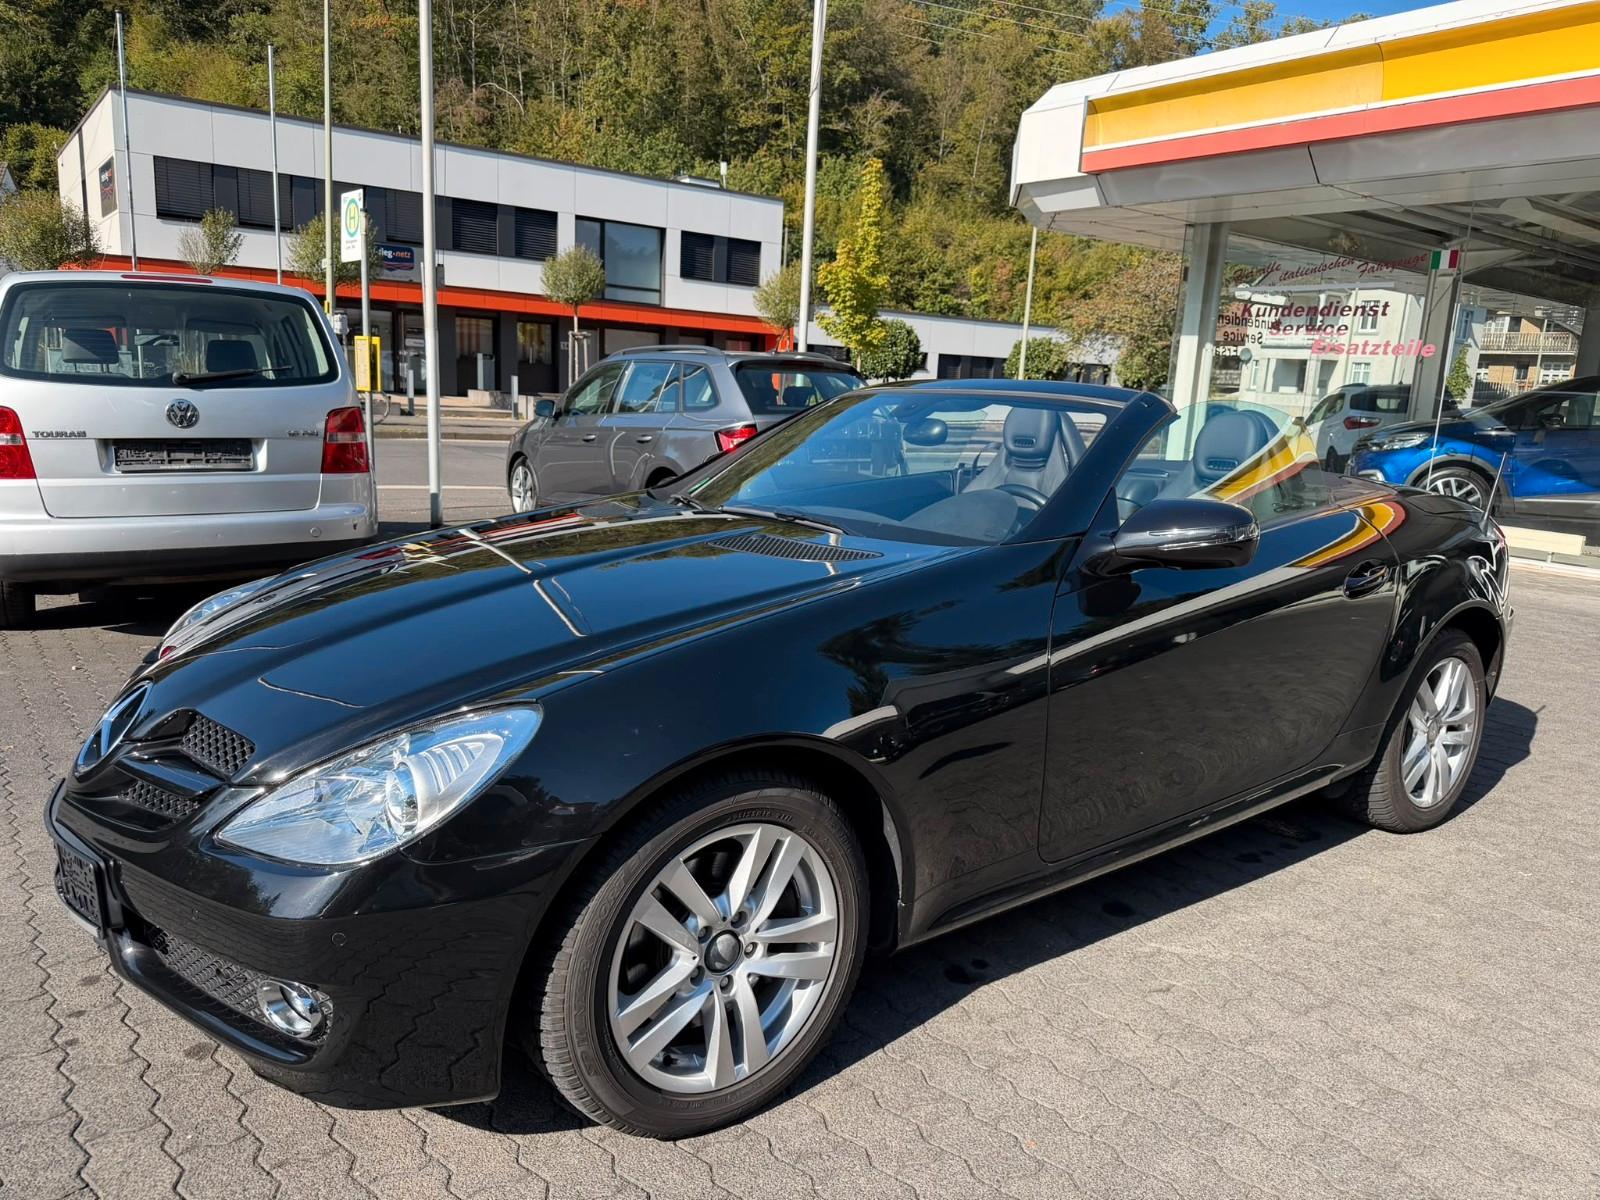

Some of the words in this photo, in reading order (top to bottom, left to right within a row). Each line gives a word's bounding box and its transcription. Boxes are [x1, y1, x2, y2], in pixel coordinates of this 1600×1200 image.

[1278, 256, 1355, 282] italienischen
[1357, 253, 1429, 278] Fahrzeuge
[1241, 301, 1391, 318] Kundendienst
[1269, 320, 1349, 336] Service
[1311, 338, 1436, 358] Ersatzteile
[31, 430, 87, 438] TOURAN
